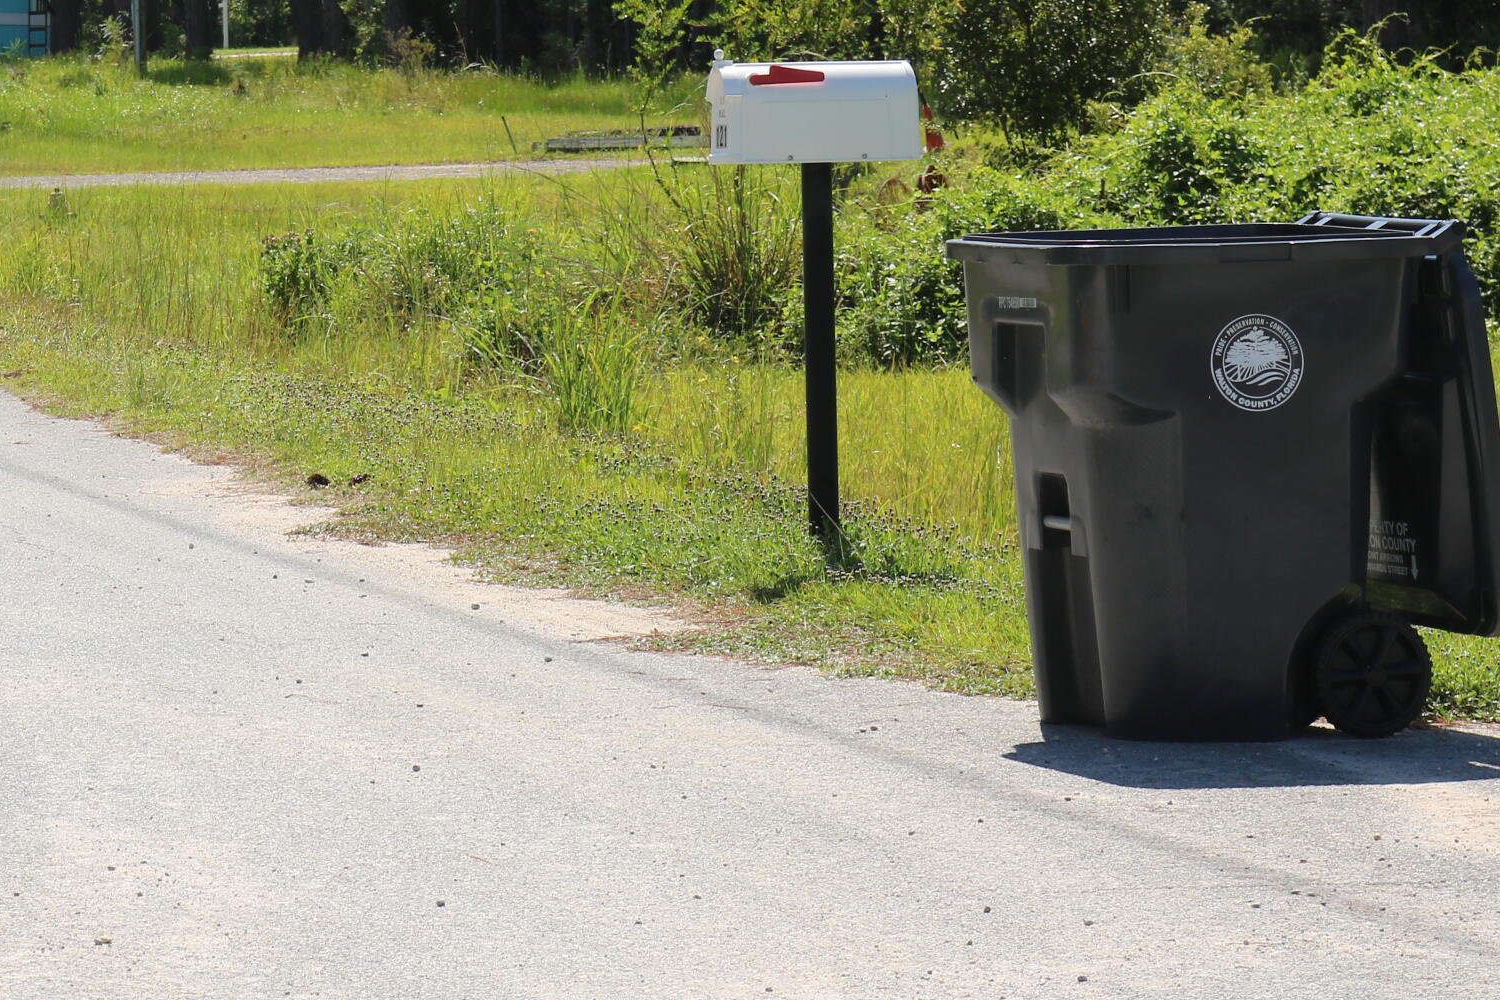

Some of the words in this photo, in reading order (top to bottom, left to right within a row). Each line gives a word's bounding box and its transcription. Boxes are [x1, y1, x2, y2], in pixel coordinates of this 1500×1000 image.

[716, 125, 727, 149] 121
[1215, 338, 1225, 356] PRIDE
[1226, 318, 1265, 336] PRESERVATION
[1269, 321, 1299, 355] CONSERVATION
[1215, 368, 1239, 401] WALTON
[1238, 397, 1277, 408] COUNTY,
[1275, 368, 1300, 401] FLORIDA
[1396, 522, 1408, 536] OF
[1381, 536, 1416, 552] COUNTY
